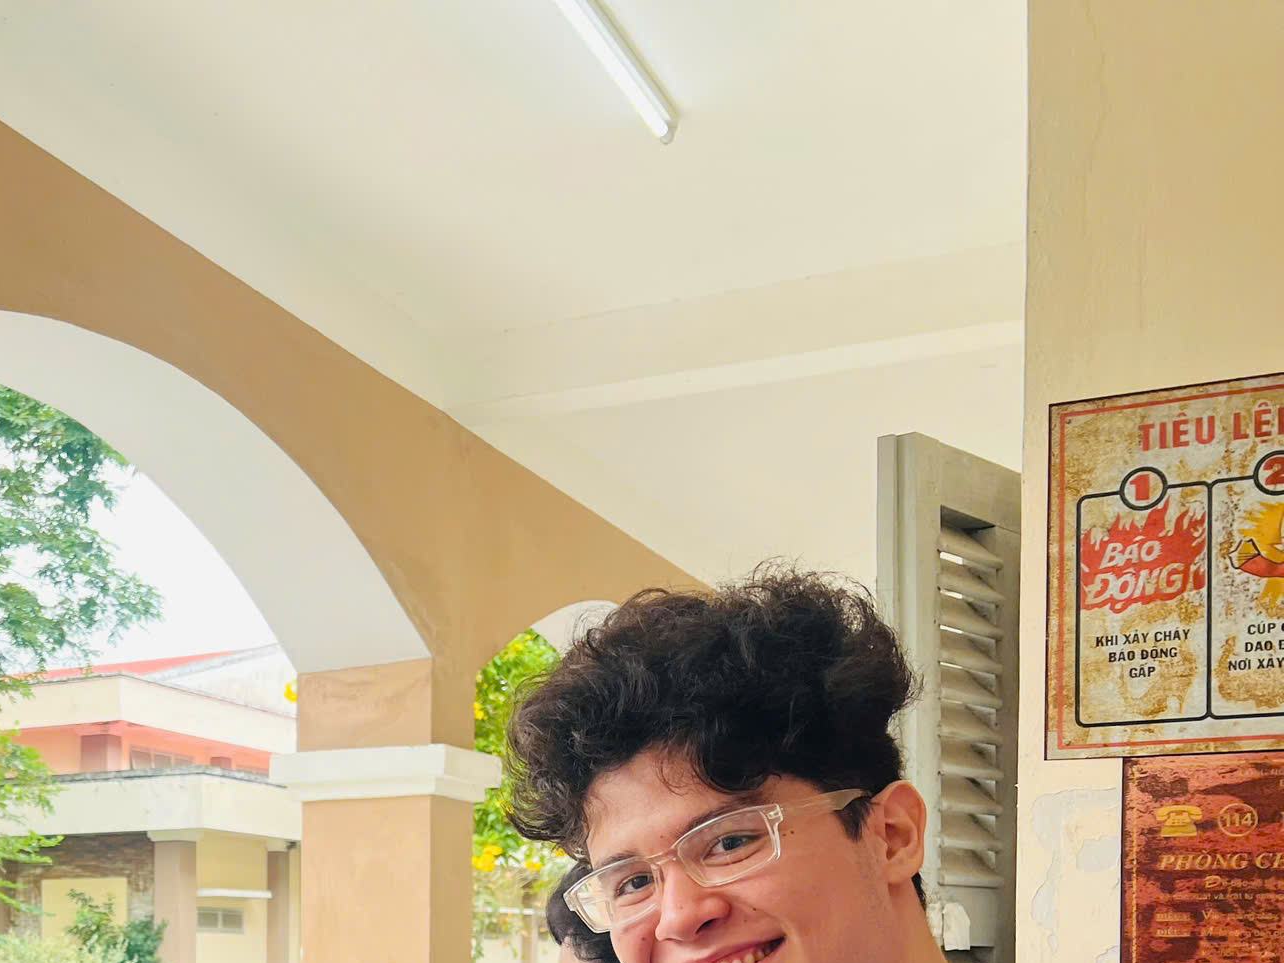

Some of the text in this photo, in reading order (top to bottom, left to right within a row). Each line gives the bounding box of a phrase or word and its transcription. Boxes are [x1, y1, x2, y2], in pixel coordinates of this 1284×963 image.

[1138, 412, 1215, 452] TIÊU
[1263, 456, 1284, 487] 2
[1130, 474, 1150, 501] 1
[1100, 536, 1162, 569] BÁO
[1247, 620, 1276, 635] CÚP
[1096, 635, 1118, 648] KHI
[1154, 628, 1191, 642] CHÁY
[1245, 640, 1273, 652] DAO
[1108, 645, 1178, 663] BÁO ĐỘNG
[1129, 662, 1156, 678] GẤP
[1228, 658, 1251, 671] NƠI
[1224, 812, 1253, 828] 114
[1158, 850, 1249, 870] PHÒNG
